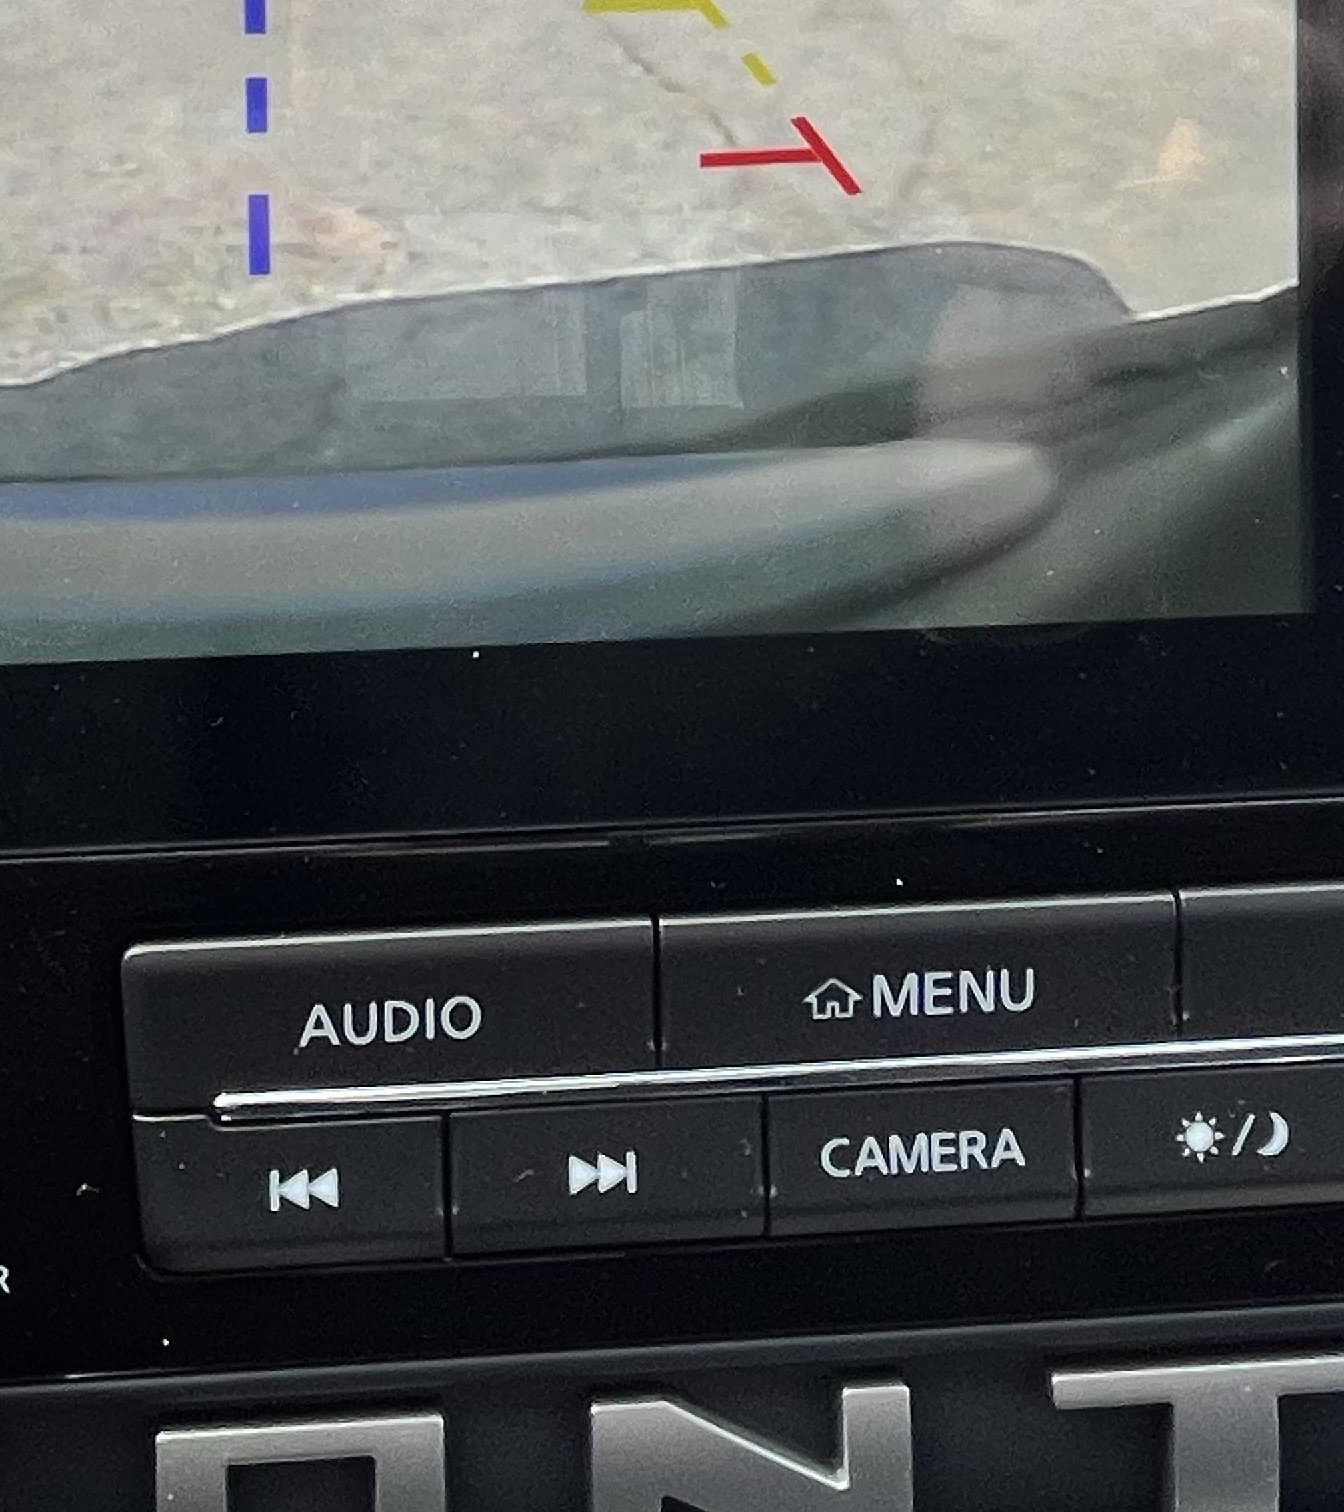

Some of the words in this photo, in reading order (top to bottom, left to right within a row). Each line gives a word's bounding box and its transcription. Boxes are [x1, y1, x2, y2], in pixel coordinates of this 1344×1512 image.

[871, 967, 1036, 1019] MENU
[298, 995, 483, 1048] AUDIO
[819, 1127, 1027, 1179] CAMERA
